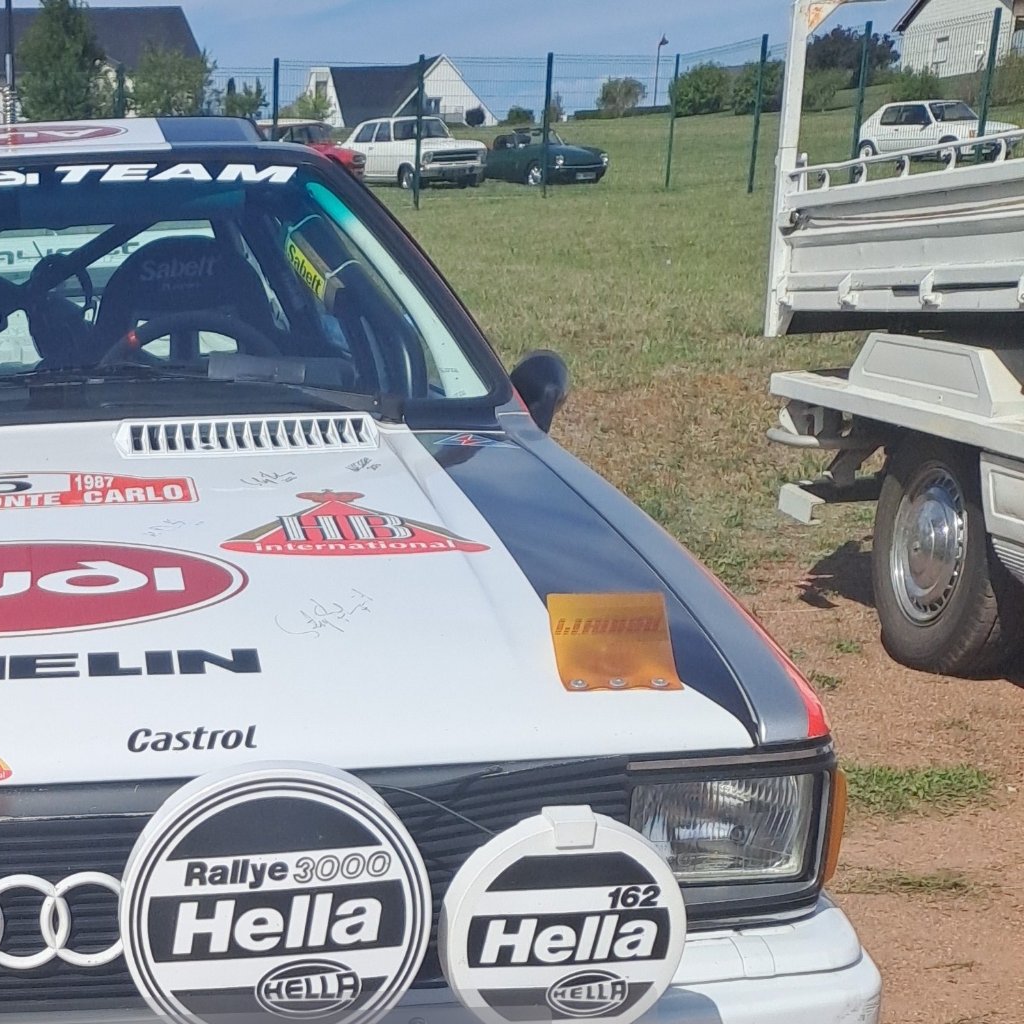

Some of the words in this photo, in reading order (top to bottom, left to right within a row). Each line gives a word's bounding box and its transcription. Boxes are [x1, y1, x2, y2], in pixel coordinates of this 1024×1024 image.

[55, 161, 298, 185] TEAM
[139, 255, 216, 281] Sabelt
[288, 244, 323, 296] Sabelt
[74, 475, 114, 492] 1987
[83, 485, 185, 504] CARLO
[277, 514, 415, 542] HB
[254, 538, 458, 553] international
[126, 724, 258, 753] Castrol
[183, 858, 289, 889] Rallye
[292, 850, 393, 884] 3000
[607, 884, 661, 910] 162
[172, 892, 384, 955] Hella
[478, 915, 660, 965] Hella
[262, 970, 361, 1001] HELLA
[553, 979, 629, 1004] HELLA
